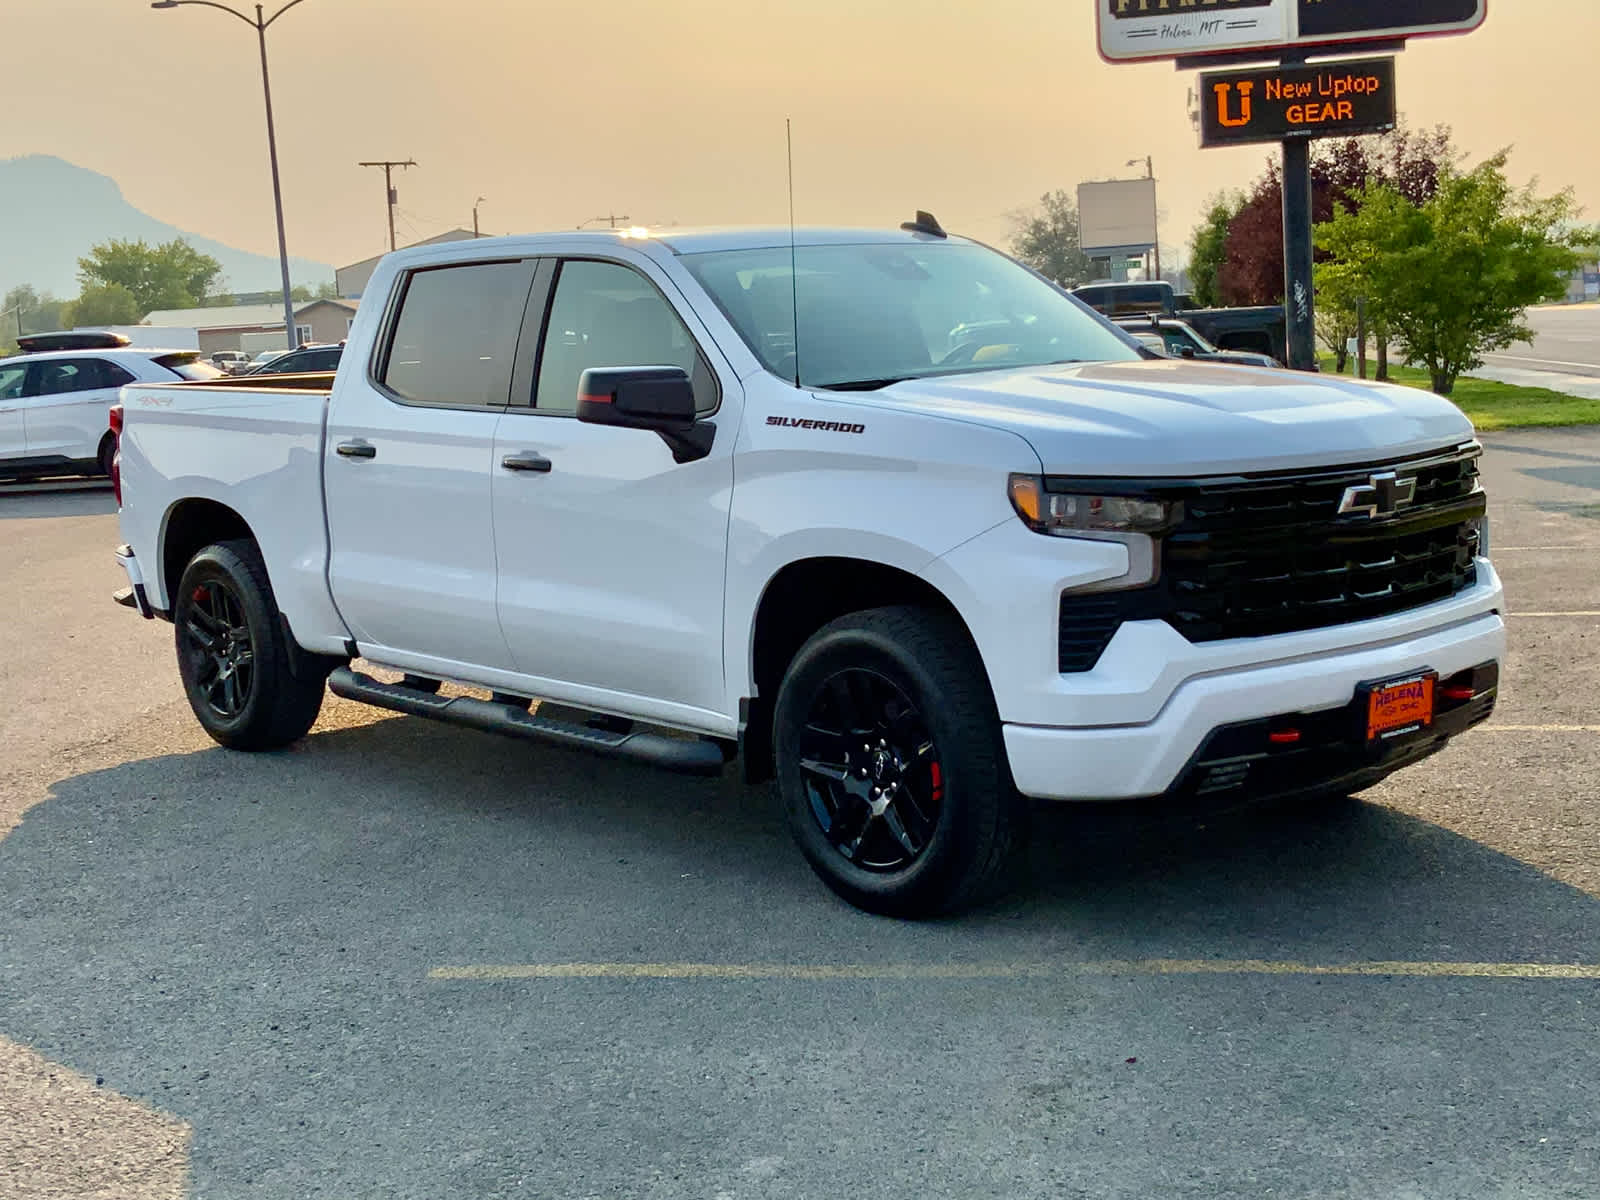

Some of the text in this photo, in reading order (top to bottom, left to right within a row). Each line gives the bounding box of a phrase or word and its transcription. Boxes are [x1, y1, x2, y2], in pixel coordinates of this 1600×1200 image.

[1199, 20, 1225, 35] MT
[1265, 74, 1379, 100] New Uptop
[1213, 81, 1254, 127] U
[1286, 101, 1353, 123] GEAR
[765, 416, 865, 434] SILVERADO
[1375, 684, 1425, 711] HELENA
